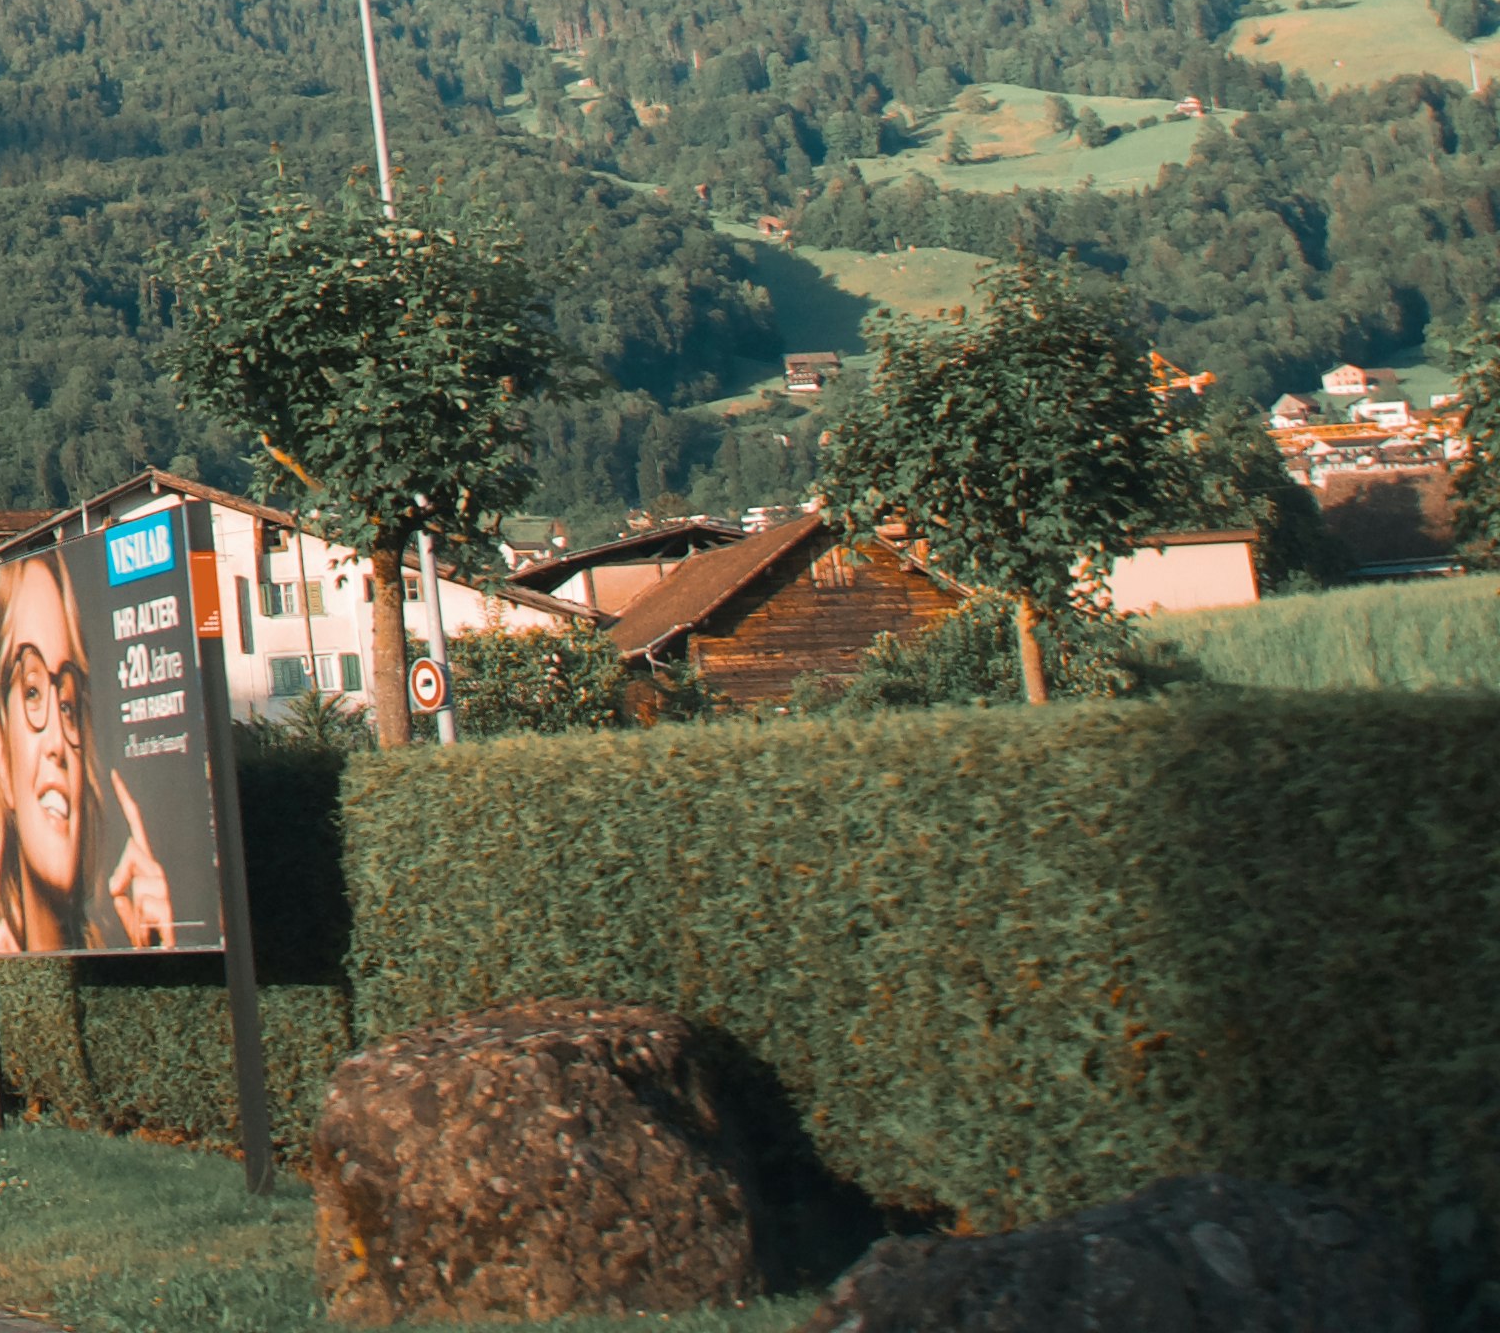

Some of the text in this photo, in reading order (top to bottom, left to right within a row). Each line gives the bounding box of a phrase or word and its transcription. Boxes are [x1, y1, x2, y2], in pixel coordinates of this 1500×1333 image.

[113, 606, 137, 641] IHR
[137, 595, 179, 635] ALTER
[148, 646, 184, 684] Jahre
